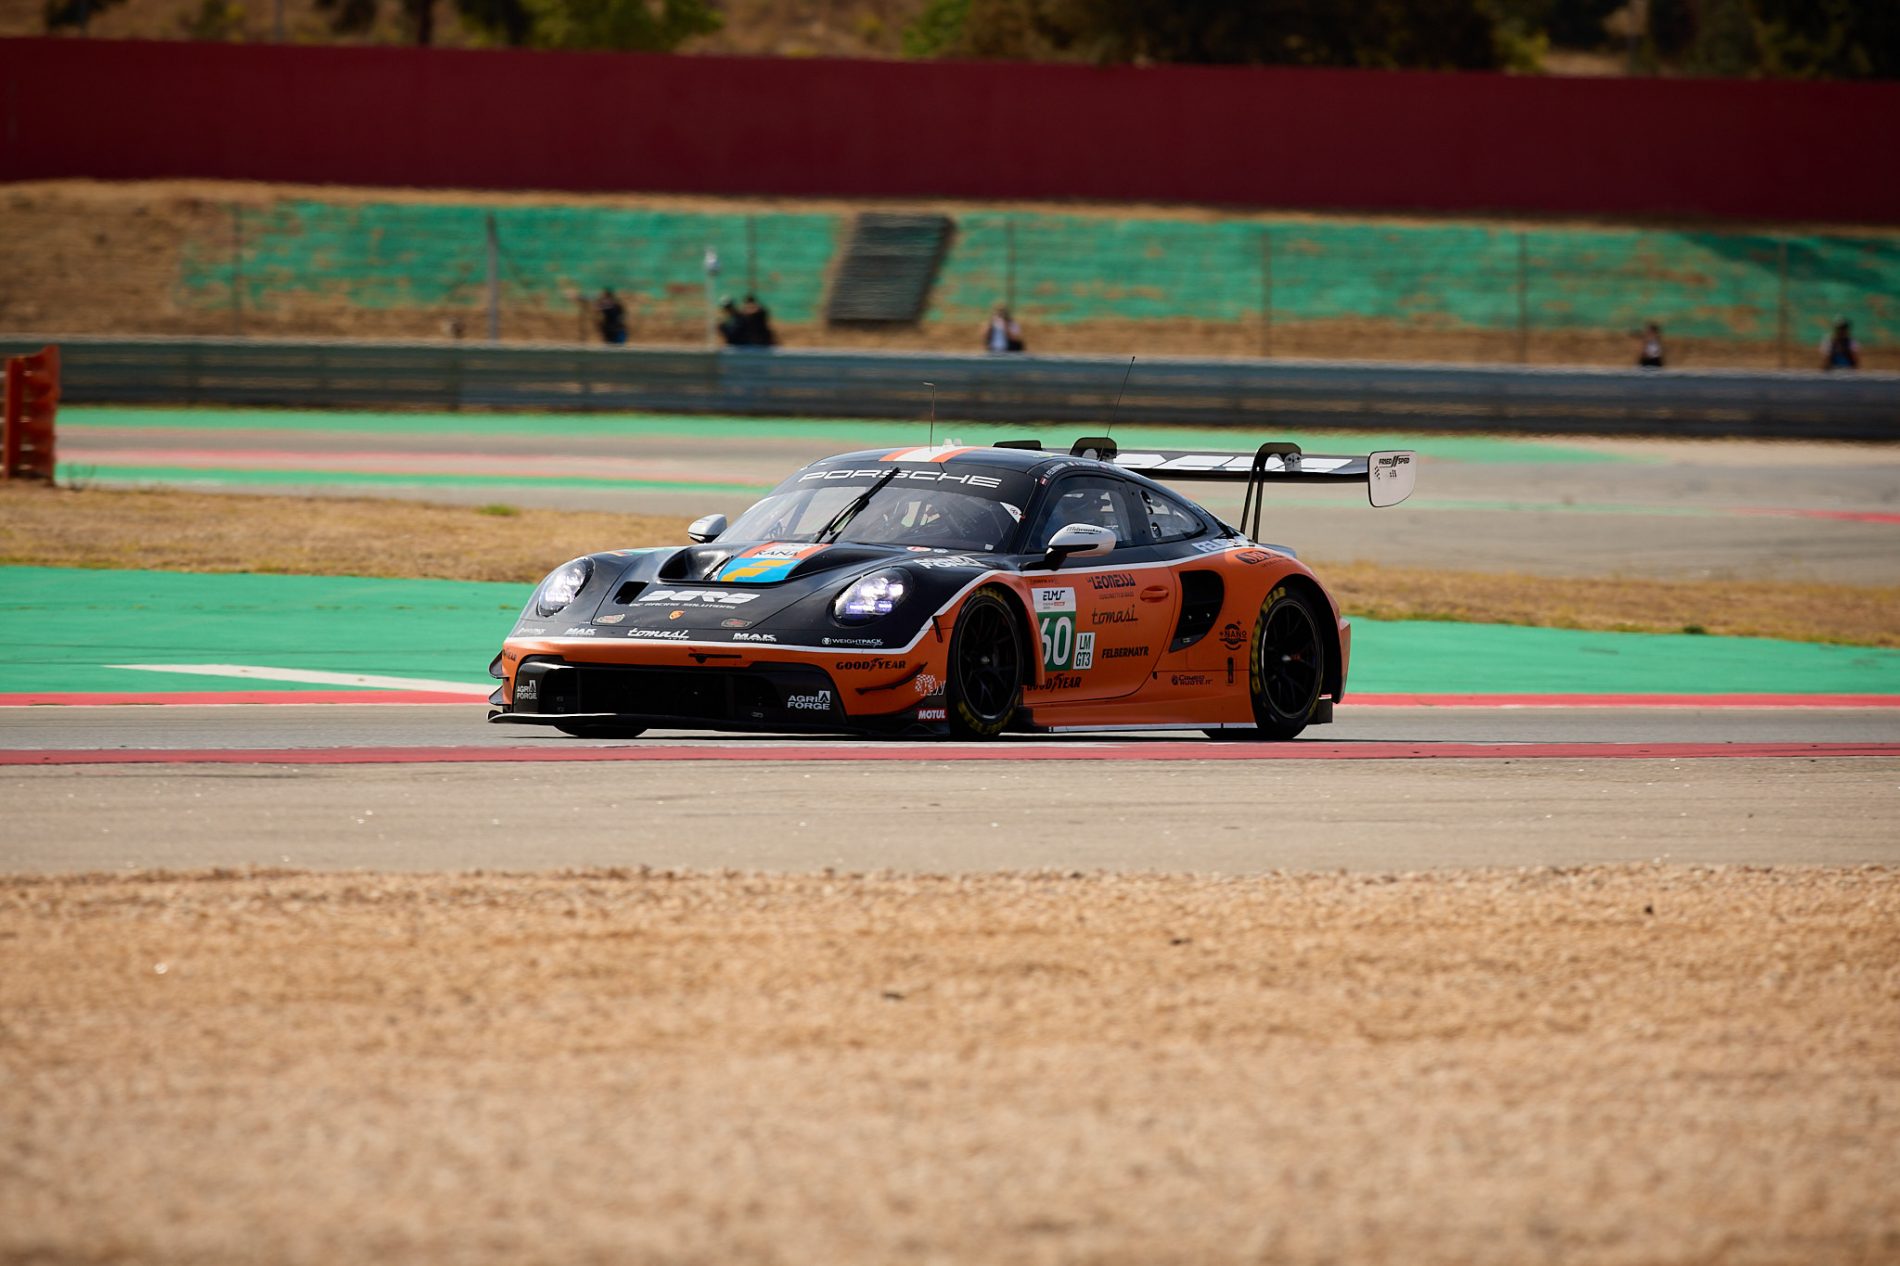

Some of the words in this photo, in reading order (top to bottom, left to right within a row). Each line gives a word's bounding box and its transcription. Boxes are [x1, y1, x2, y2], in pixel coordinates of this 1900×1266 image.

[798, 469, 1002, 488] PORSCHE
[1091, 604, 1139, 625] tomasi
[627, 627, 690, 640] tomasi
[733, 632, 777, 641] MAK
[832, 637, 883, 645] WEIGHTPACK
[1040, 616, 1072, 666] 60
[1079, 635, 1091, 650] LM
[1076, 651, 1091, 667] GT3
[1102, 646, 1149, 659] FELBERMAYR
[788, 694, 819, 703] AGRI
[787, 701, 831, 711] FORGE
[918, 709, 946, 720] MOTUL
